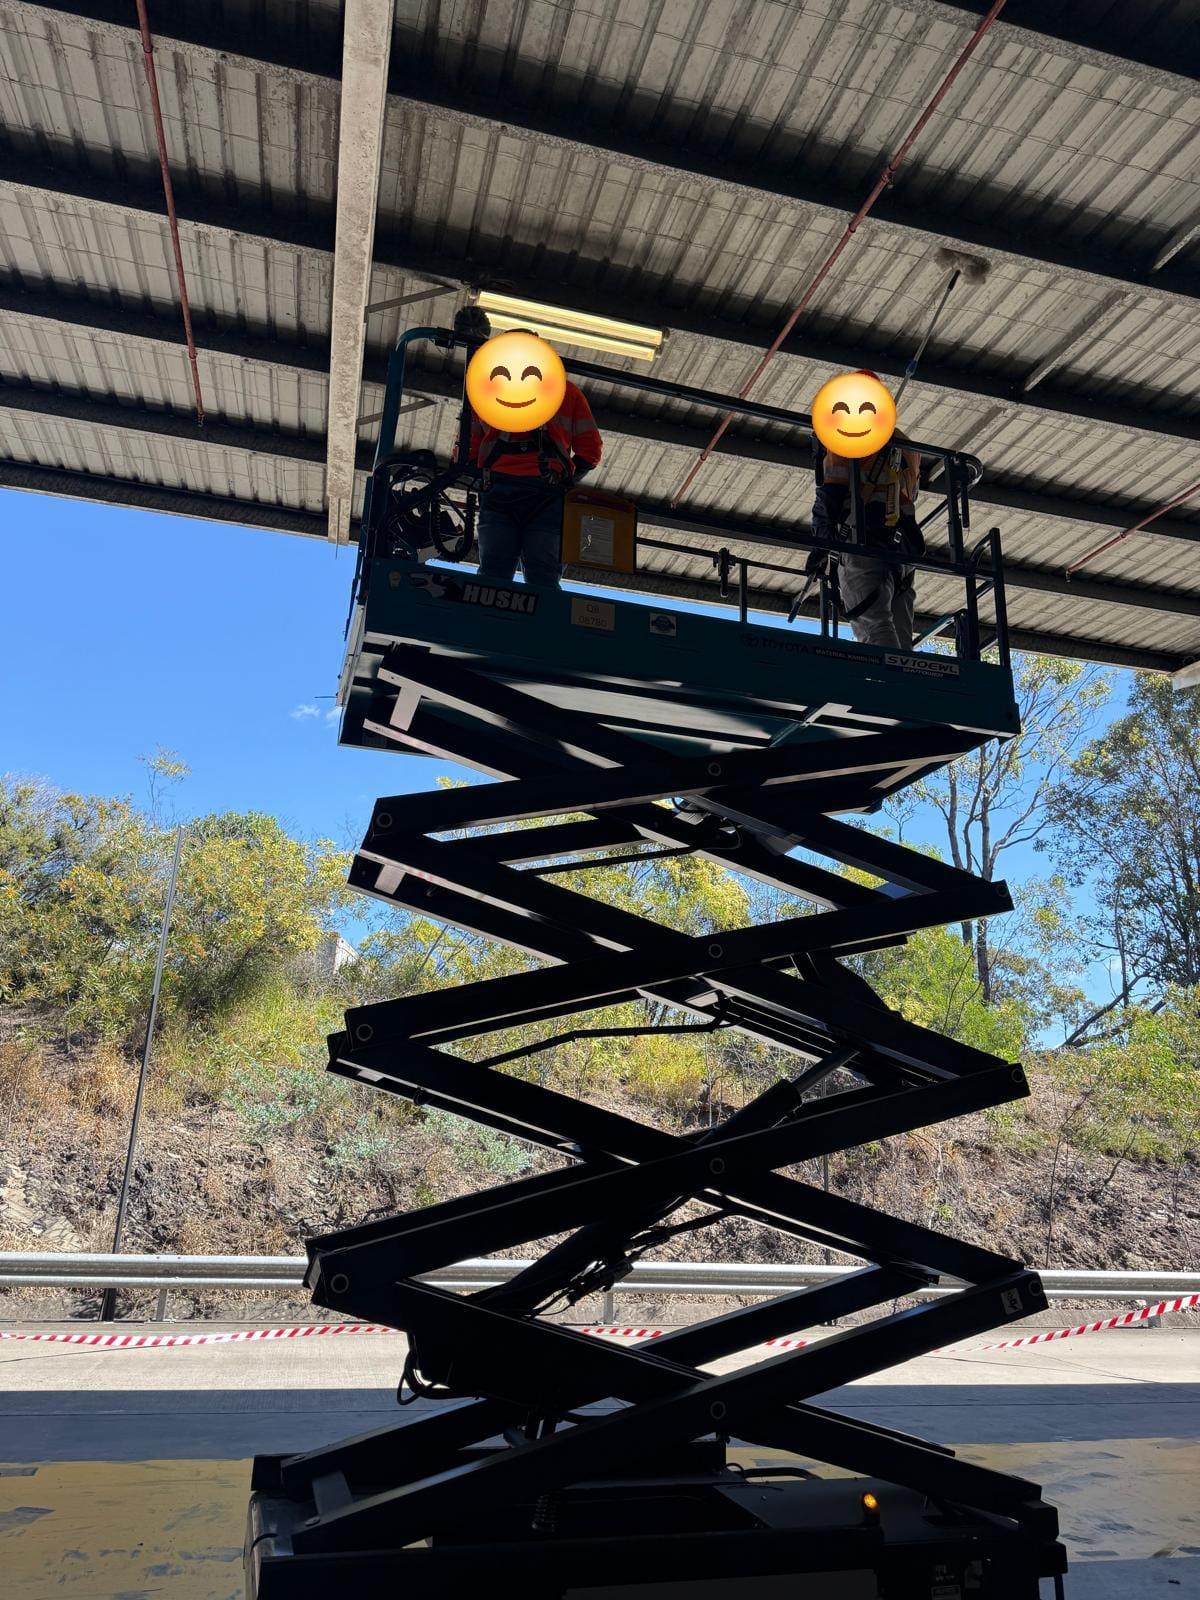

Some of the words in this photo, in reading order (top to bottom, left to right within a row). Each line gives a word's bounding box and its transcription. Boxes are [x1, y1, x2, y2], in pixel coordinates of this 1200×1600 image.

[463, 584, 536, 614] HUSKI
[760, 638, 808, 653] TOYOTA
[887, 656, 957, 674] SV10EWL
